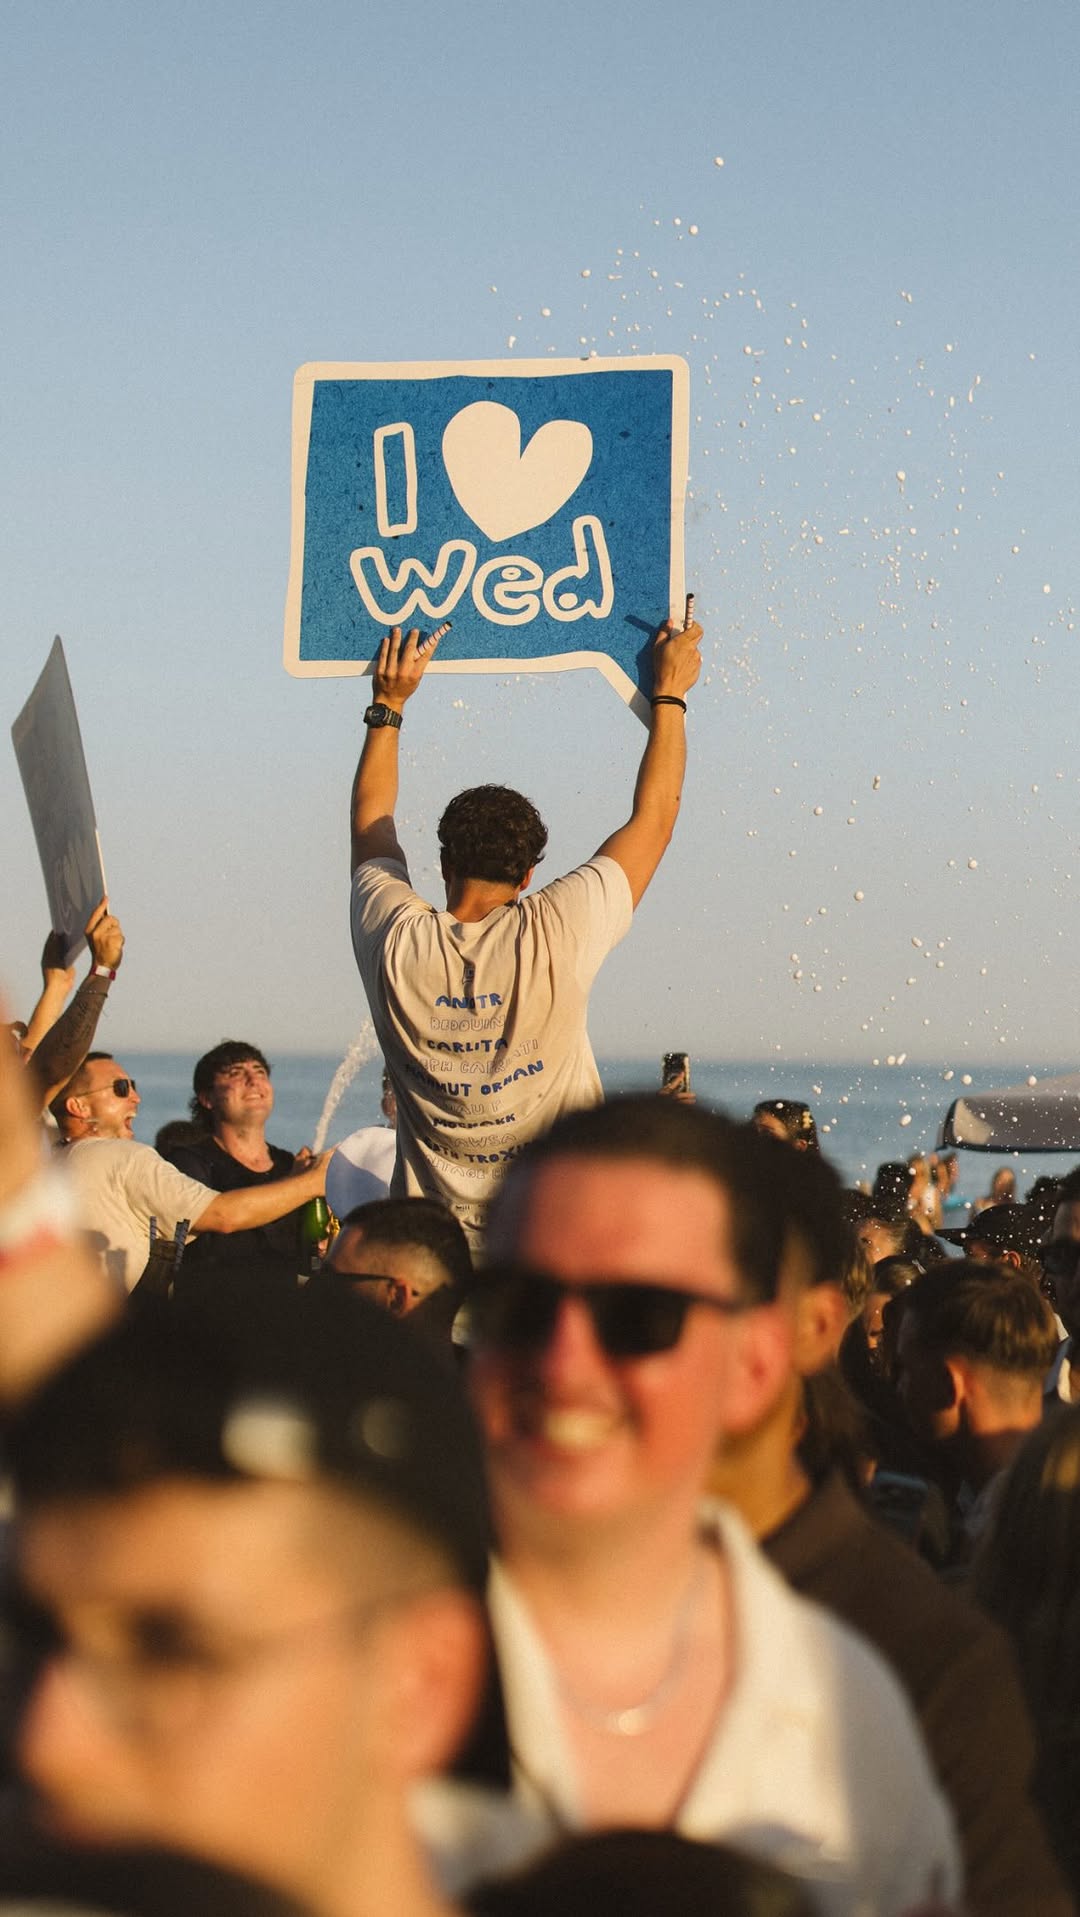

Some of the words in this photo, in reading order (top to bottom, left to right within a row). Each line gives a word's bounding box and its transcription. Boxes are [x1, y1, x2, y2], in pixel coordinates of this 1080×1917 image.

[374, 422, 418, 537] I
[350, 515, 614, 625] Wed
[430, 1015, 506, 1032] BEDOUIN
[427, 1038, 508, 1053] CARLITA
[480, 1060, 544, 1096] ORHAN
[434, 1133, 516, 1148] AWSA
